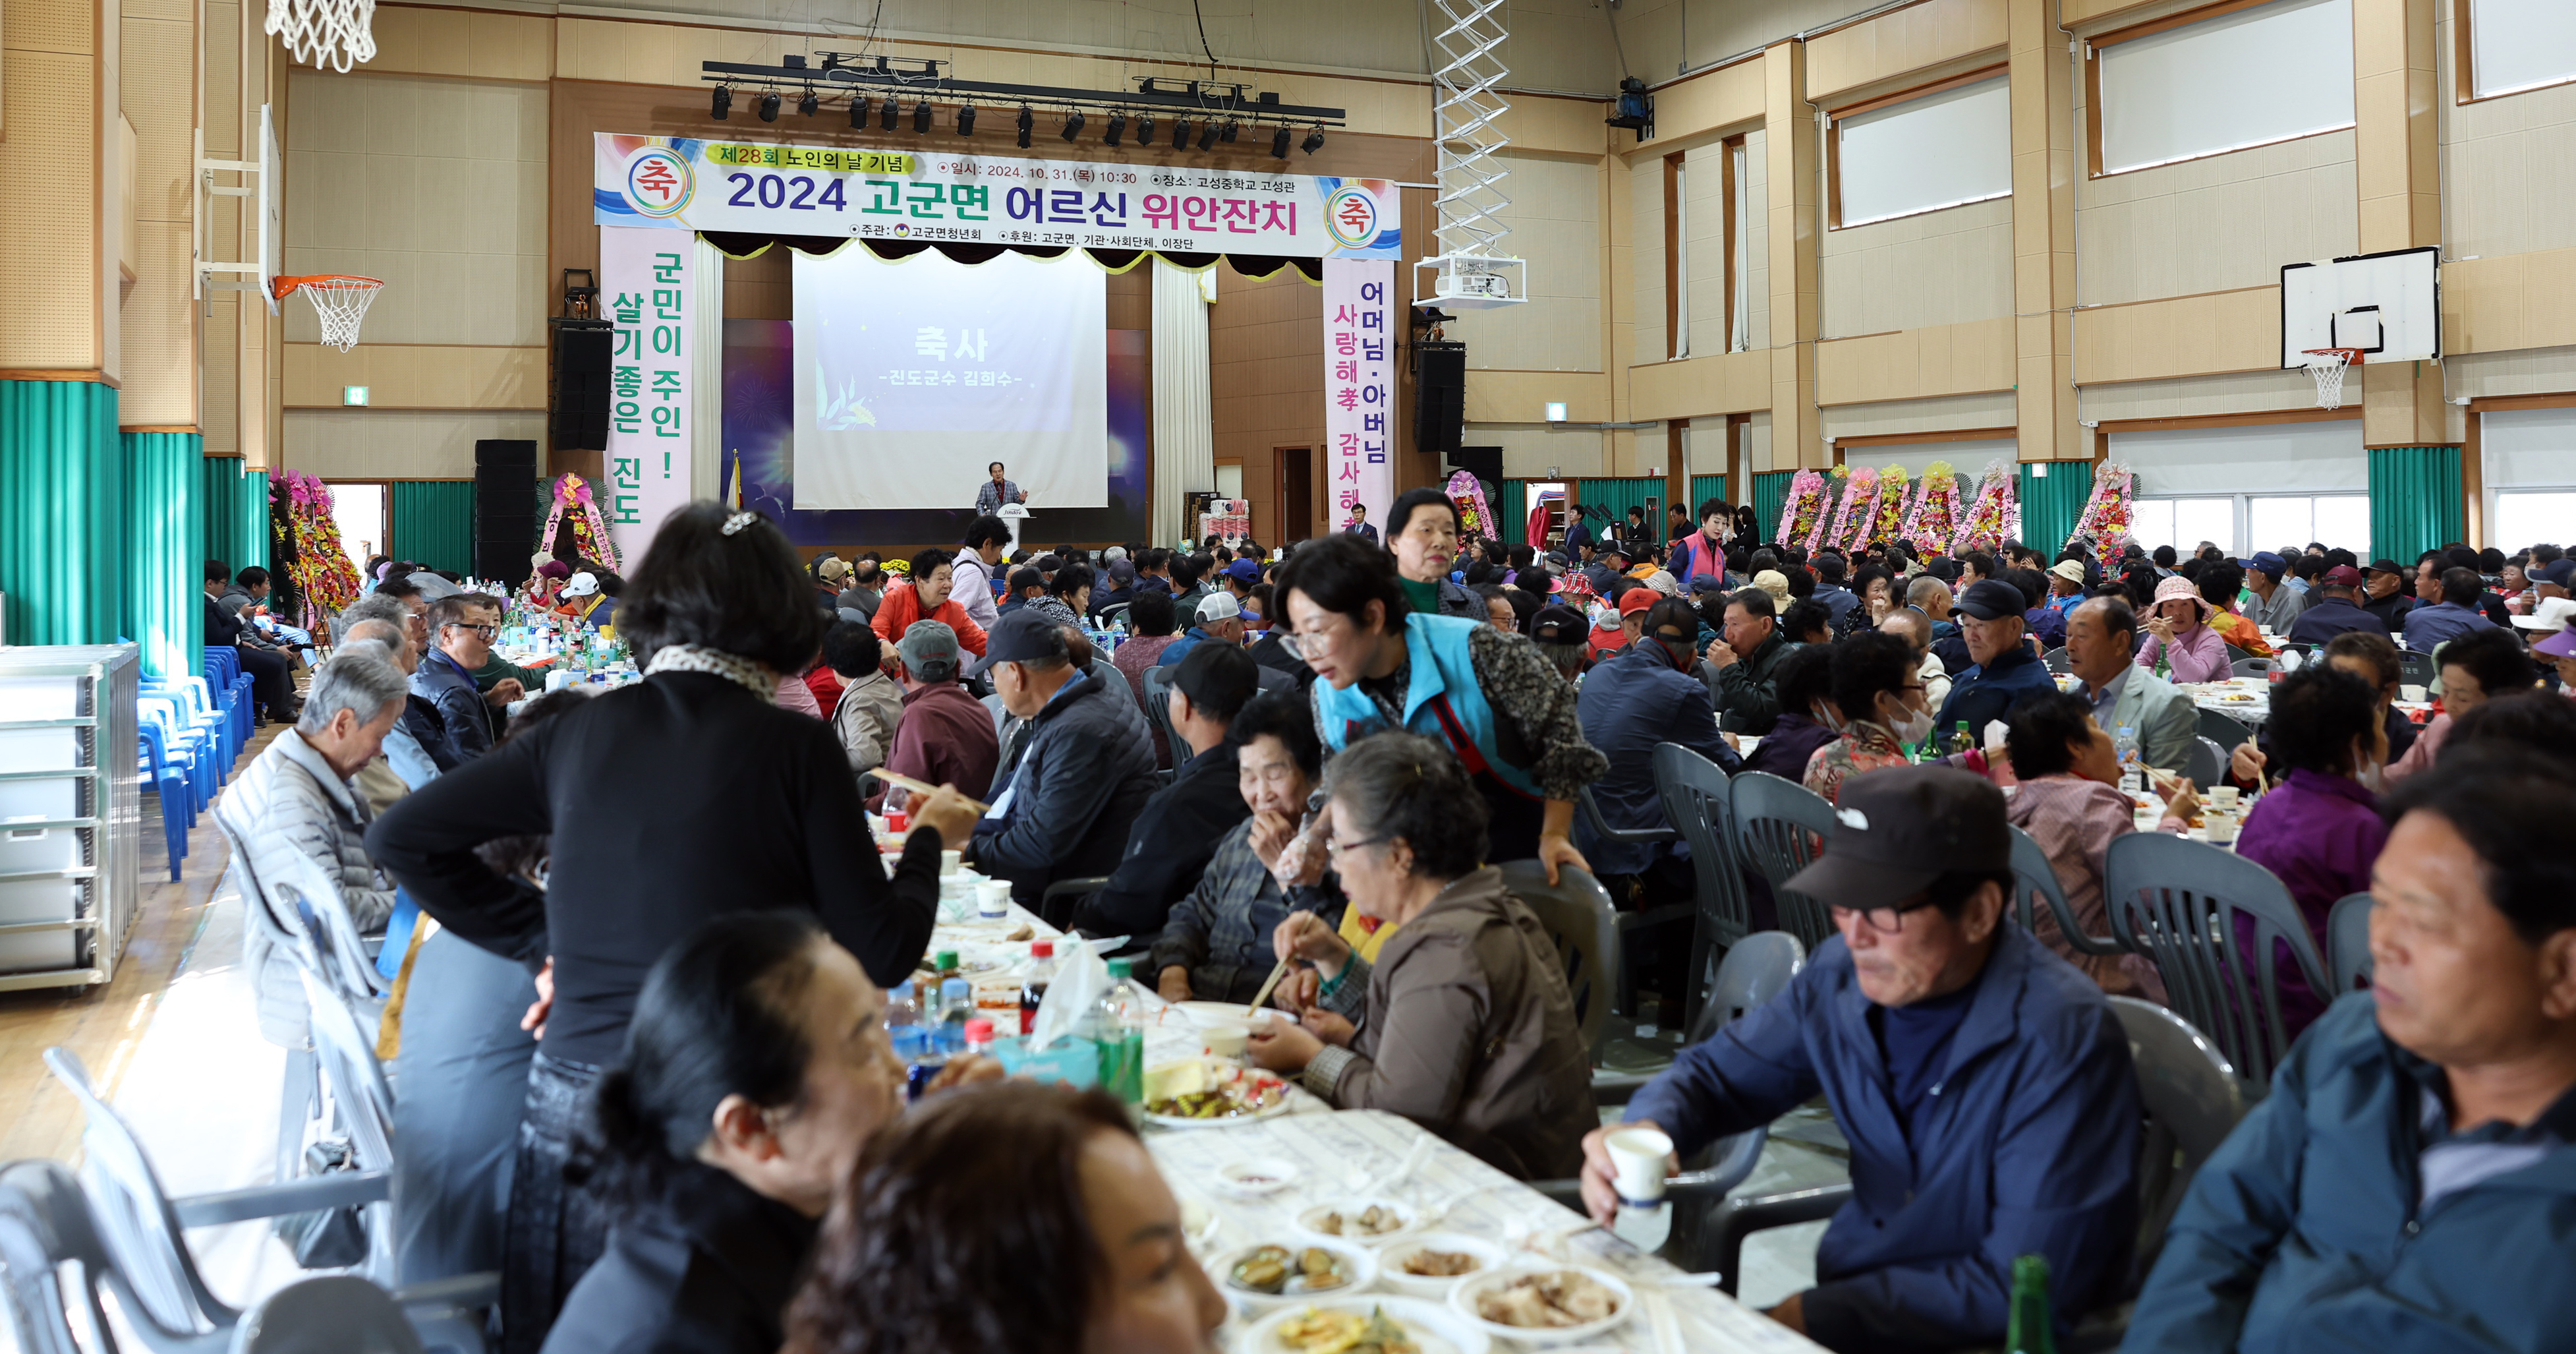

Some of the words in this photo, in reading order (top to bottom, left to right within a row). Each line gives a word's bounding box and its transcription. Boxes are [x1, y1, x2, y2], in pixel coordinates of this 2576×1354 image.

[720, 146, 780, 166] 제28회
[786, 150, 842, 171] 노인의
[845, 152, 863, 171] 날
[869, 154, 903, 173] 기념
[951, 161, 982, 176] 일시:
[987, 165, 1025, 179] 2024.
[1028, 167, 1049, 180] 10.
[1099, 171, 1137, 185] 10:30
[636, 160, 678, 200] 축
[1162, 174, 1193, 189] 장소:
[1197, 175, 1257, 191] 고성중학교
[1260, 177, 1296, 194] 고성관
[727, 173, 848, 212] 2024
[861, 179, 989, 221] 고군면
[1006, 186, 1127, 228] 어르신
[1141, 192, 1297, 236] 위안잔치
[1338, 198, 1371, 233] 축
[861, 224, 890, 237] 주관:
[911, 226, 982, 241] 고군면청년회
[1010, 230, 1037, 243] 후원:
[1041, 233, 1079, 247] 고군면,
[1162, 238, 1194, 250] 이장단
[915, 326, 988, 362] 축사
[612, 457, 641, 525] 진도
[1480, 509, 1490, 528] 2024
